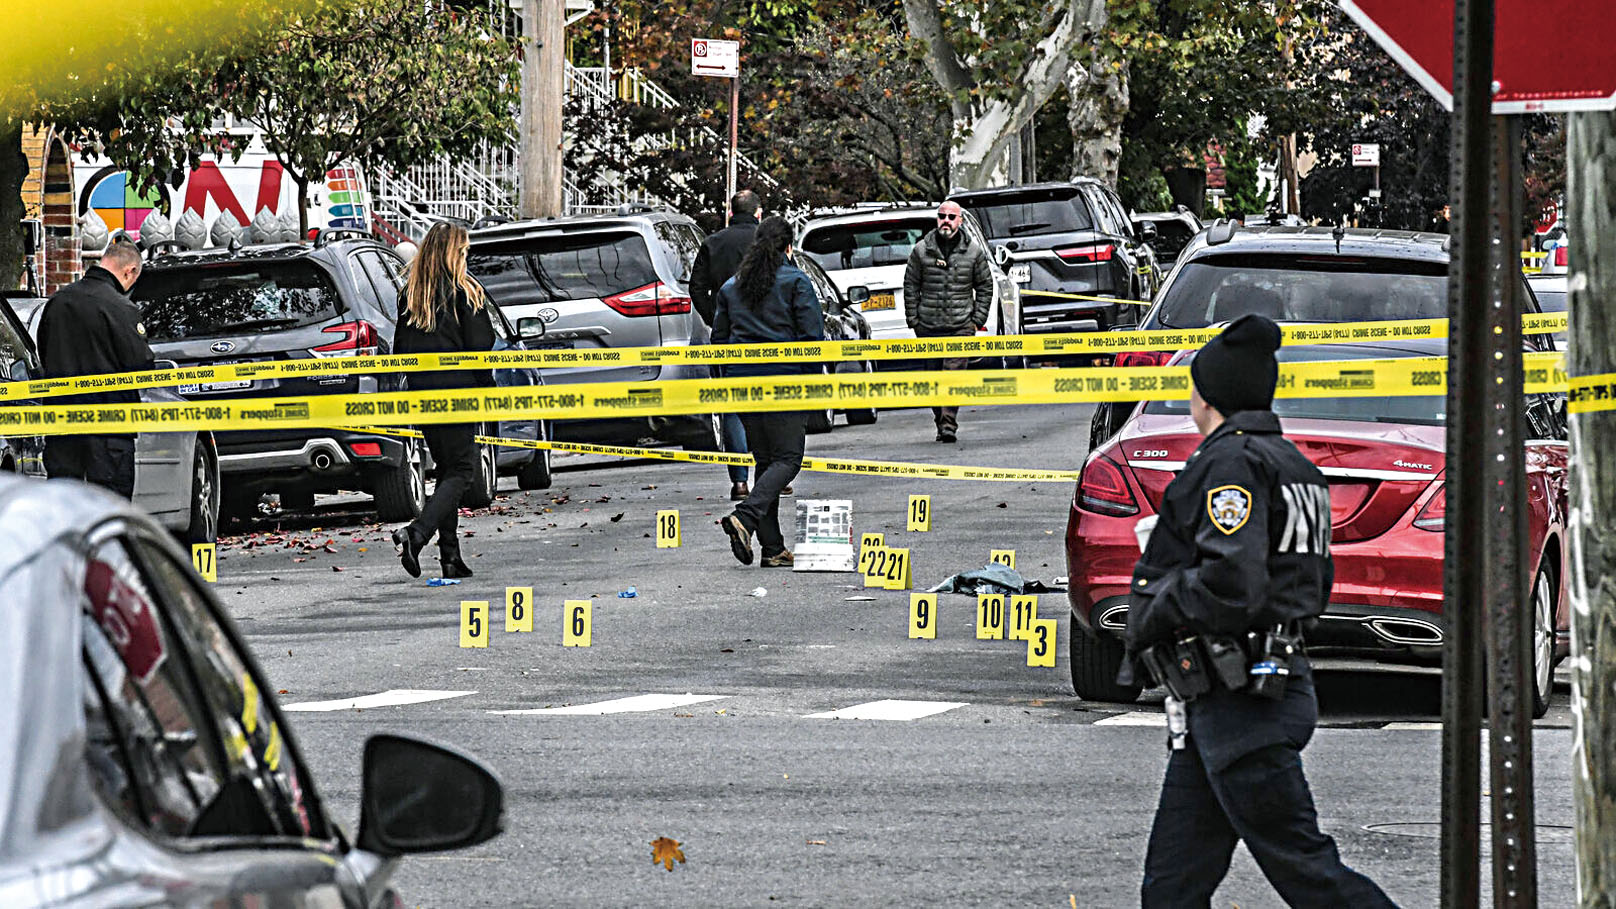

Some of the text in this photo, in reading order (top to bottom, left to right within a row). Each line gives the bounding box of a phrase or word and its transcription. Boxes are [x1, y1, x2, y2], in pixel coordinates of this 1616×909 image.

[1393, 460, 1432, 470] 4MATIC
[912, 500, 926, 522] 19
[660, 515, 676, 539] 18
[197, 549, 211, 573] 17
[868, 551, 886, 576] 22
[888, 553, 904, 580] 21
[512, 592, 523, 620] 8
[917, 600, 928, 628] 9
[982, 599, 1000, 628] 10
[1016, 601, 1032, 630] 11
[469, 608, 480, 637] 5
[573, 607, 584, 636] 6
[1034, 626, 1047, 656] 3
